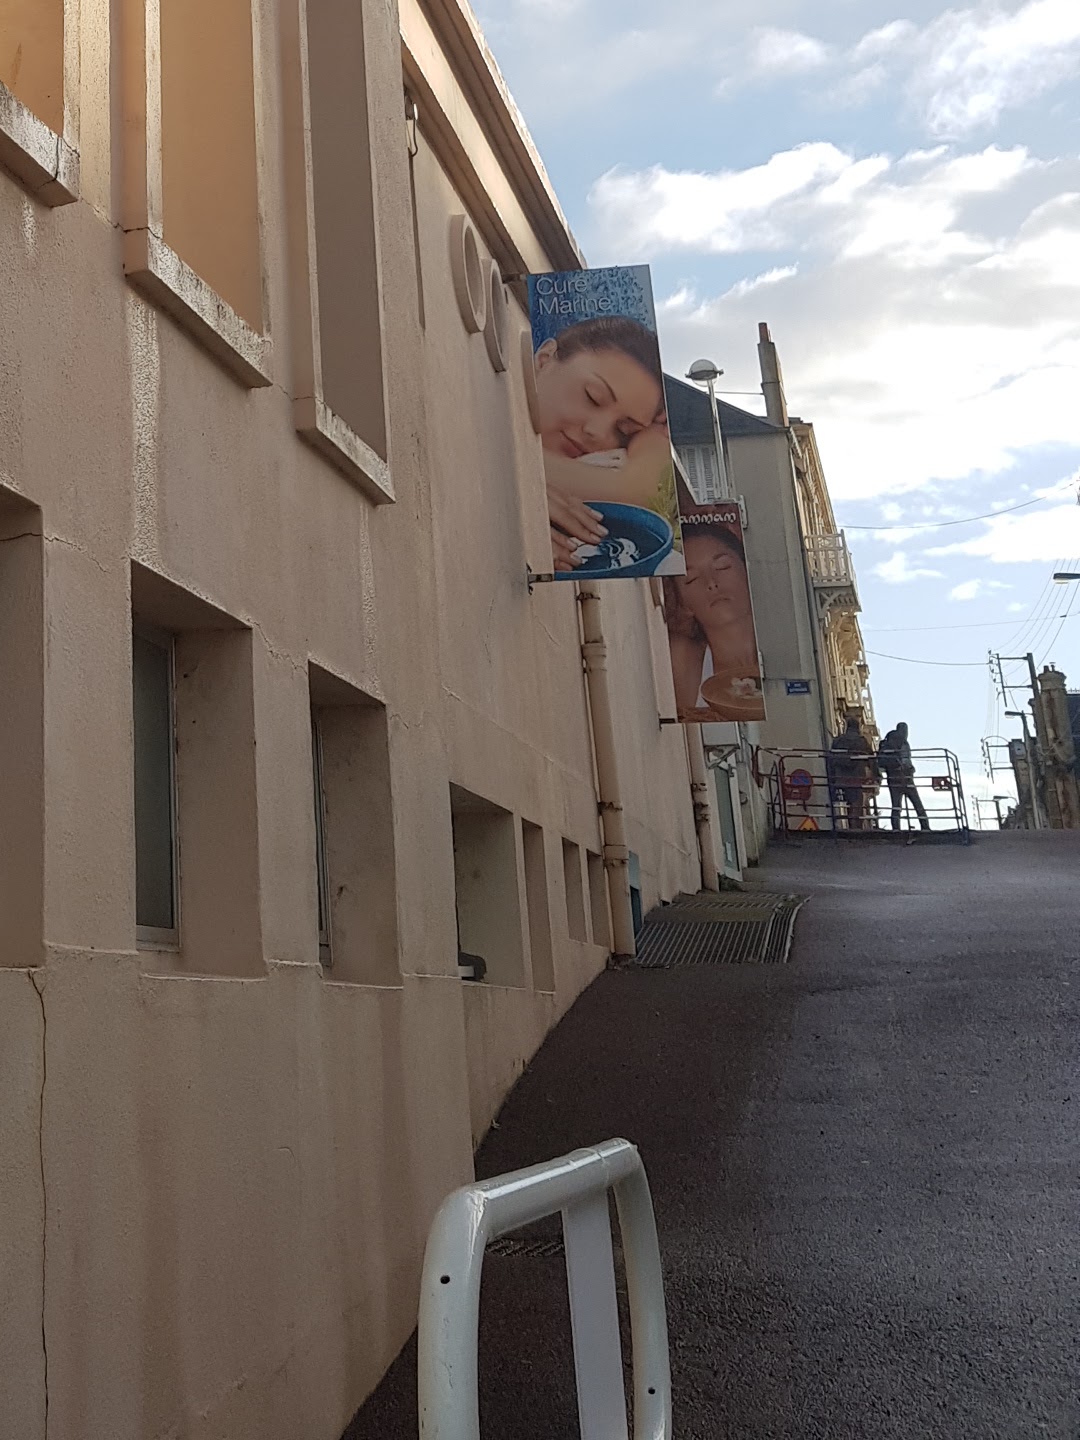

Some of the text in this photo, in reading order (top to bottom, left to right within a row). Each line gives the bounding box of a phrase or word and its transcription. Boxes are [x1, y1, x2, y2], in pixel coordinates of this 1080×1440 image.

[536, 277, 587, 295] Cure
[538, 296, 611, 315] Marine
[680, 512, 736, 524] ammam
